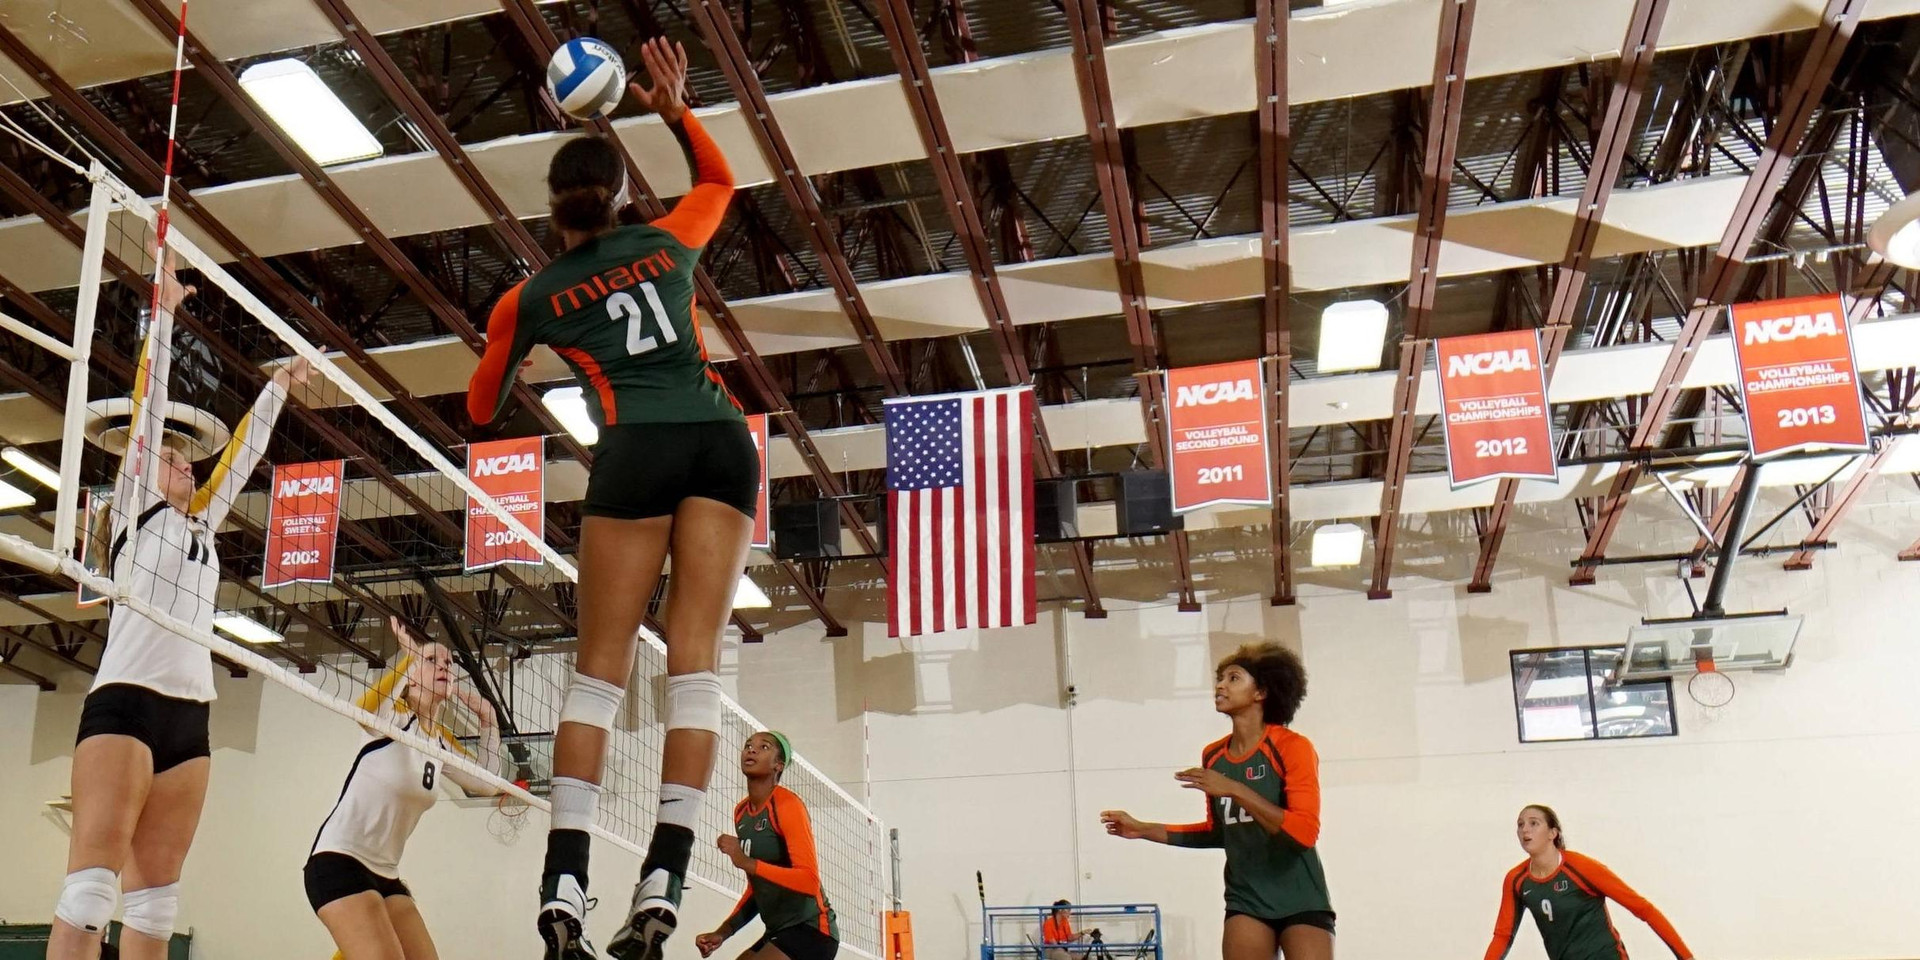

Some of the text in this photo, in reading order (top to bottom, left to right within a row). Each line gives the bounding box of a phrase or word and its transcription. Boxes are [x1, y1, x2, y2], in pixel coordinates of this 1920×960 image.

[606, 281, 678, 355] 21
[1744, 312, 1837, 346] NCAA
[1448, 349, 1532, 378] NCAA
[1758, 363, 1835, 380] VOLLEYBALL
[1747, 372, 1850, 392] CHAMPIONSHIPS
[1175, 379, 1254, 408] NCAA
[1459, 397, 1528, 411] VOLLEYBALL
[1449, 406, 1542, 422] CHAMPIONSHIPS
[1777, 405, 1836, 428] 2013
[1175, 434, 1259, 451] SECOND ROUND
[1185, 426, 1248, 440] VOLLEYBALL
[1474, 437, 1528, 458] 2012
[474, 453, 535, 477] NCAA
[1197, 465, 1243, 485] 2011
[278, 476, 334, 499] NCAA
[284, 525, 310, 535] SWEET
[281, 550, 320, 566] 2002
[422, 760, 436, 791] 8
[1541, 898, 1553, 921] 9
